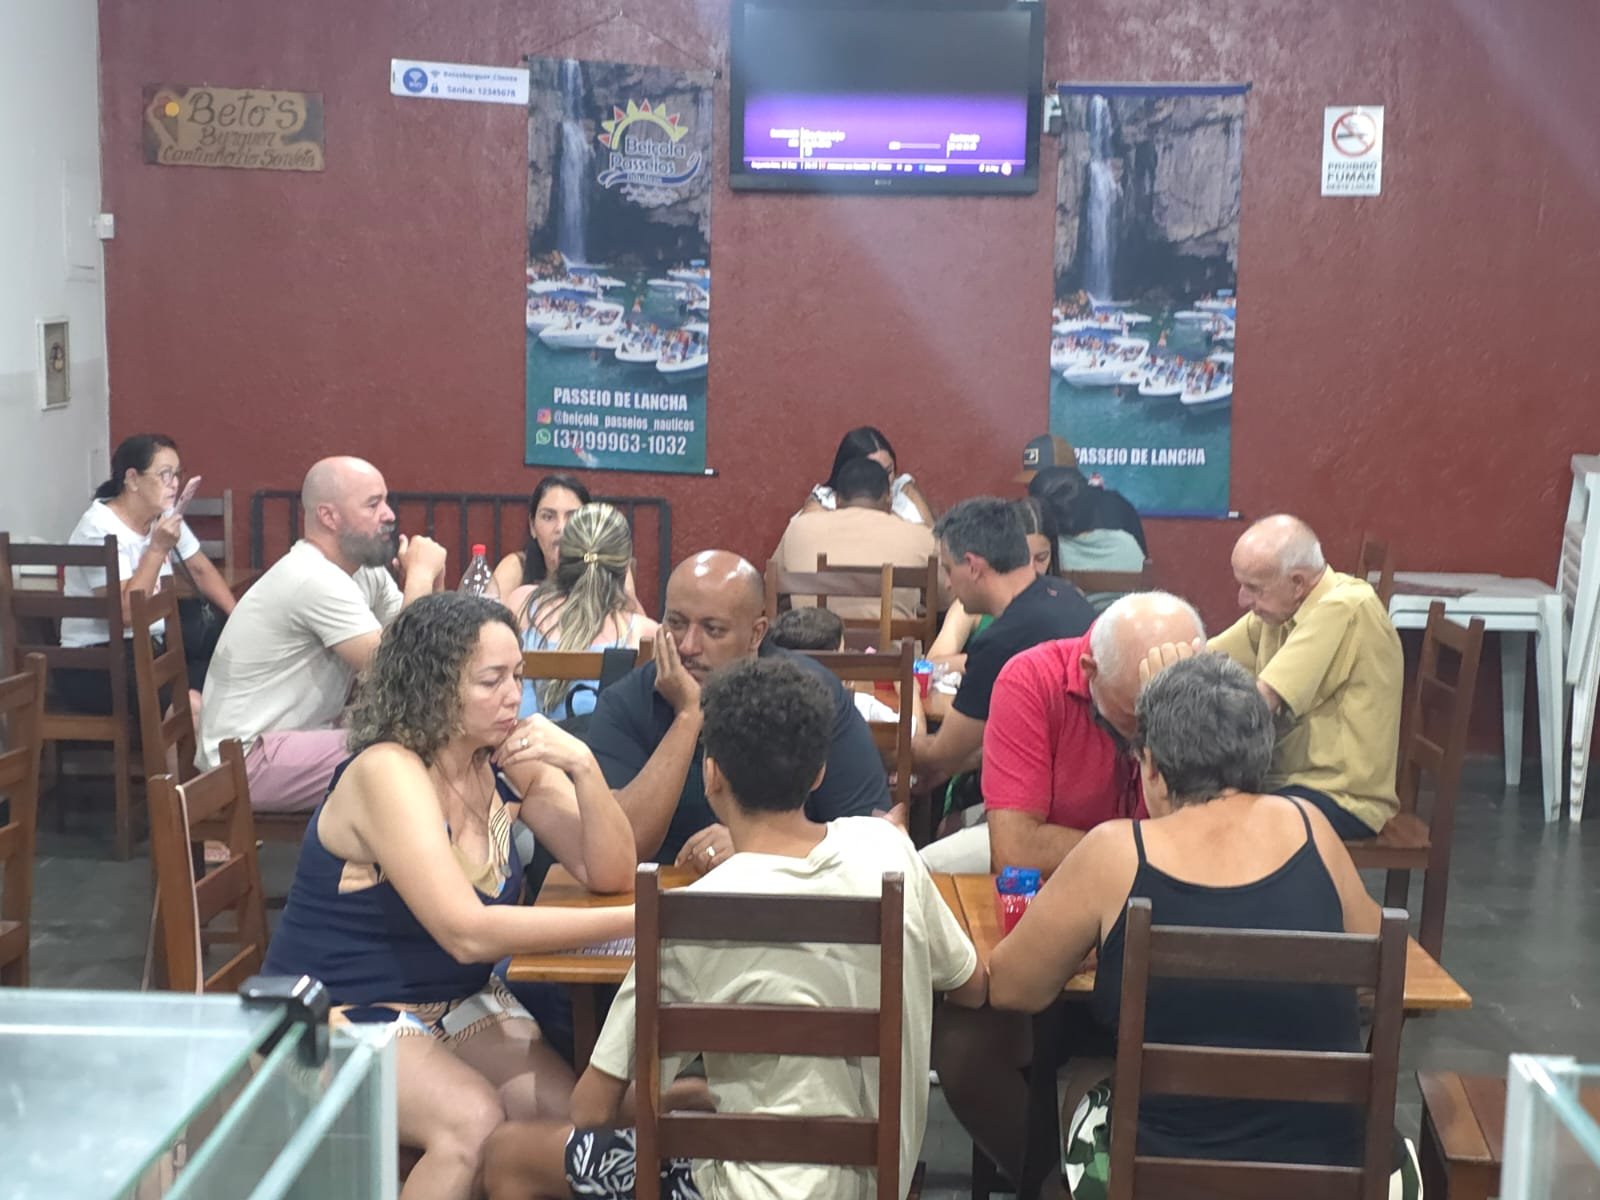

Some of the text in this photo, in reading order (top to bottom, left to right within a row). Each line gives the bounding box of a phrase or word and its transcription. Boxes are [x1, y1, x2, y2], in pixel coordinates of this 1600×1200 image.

[447, 85, 475, 96] Senha:
[609, 152, 675, 174] Passeios
[1327, 161, 1377, 170] PROIBIDO
[1327, 171, 1376, 182] FUMAR
[553, 387, 688, 411] PASSEIO DE LANCHA
[553, 429, 687, 455] (37)99963-1032
[1130, 448, 1147, 465] DE
[1151, 447, 1205, 466] LANCHA
